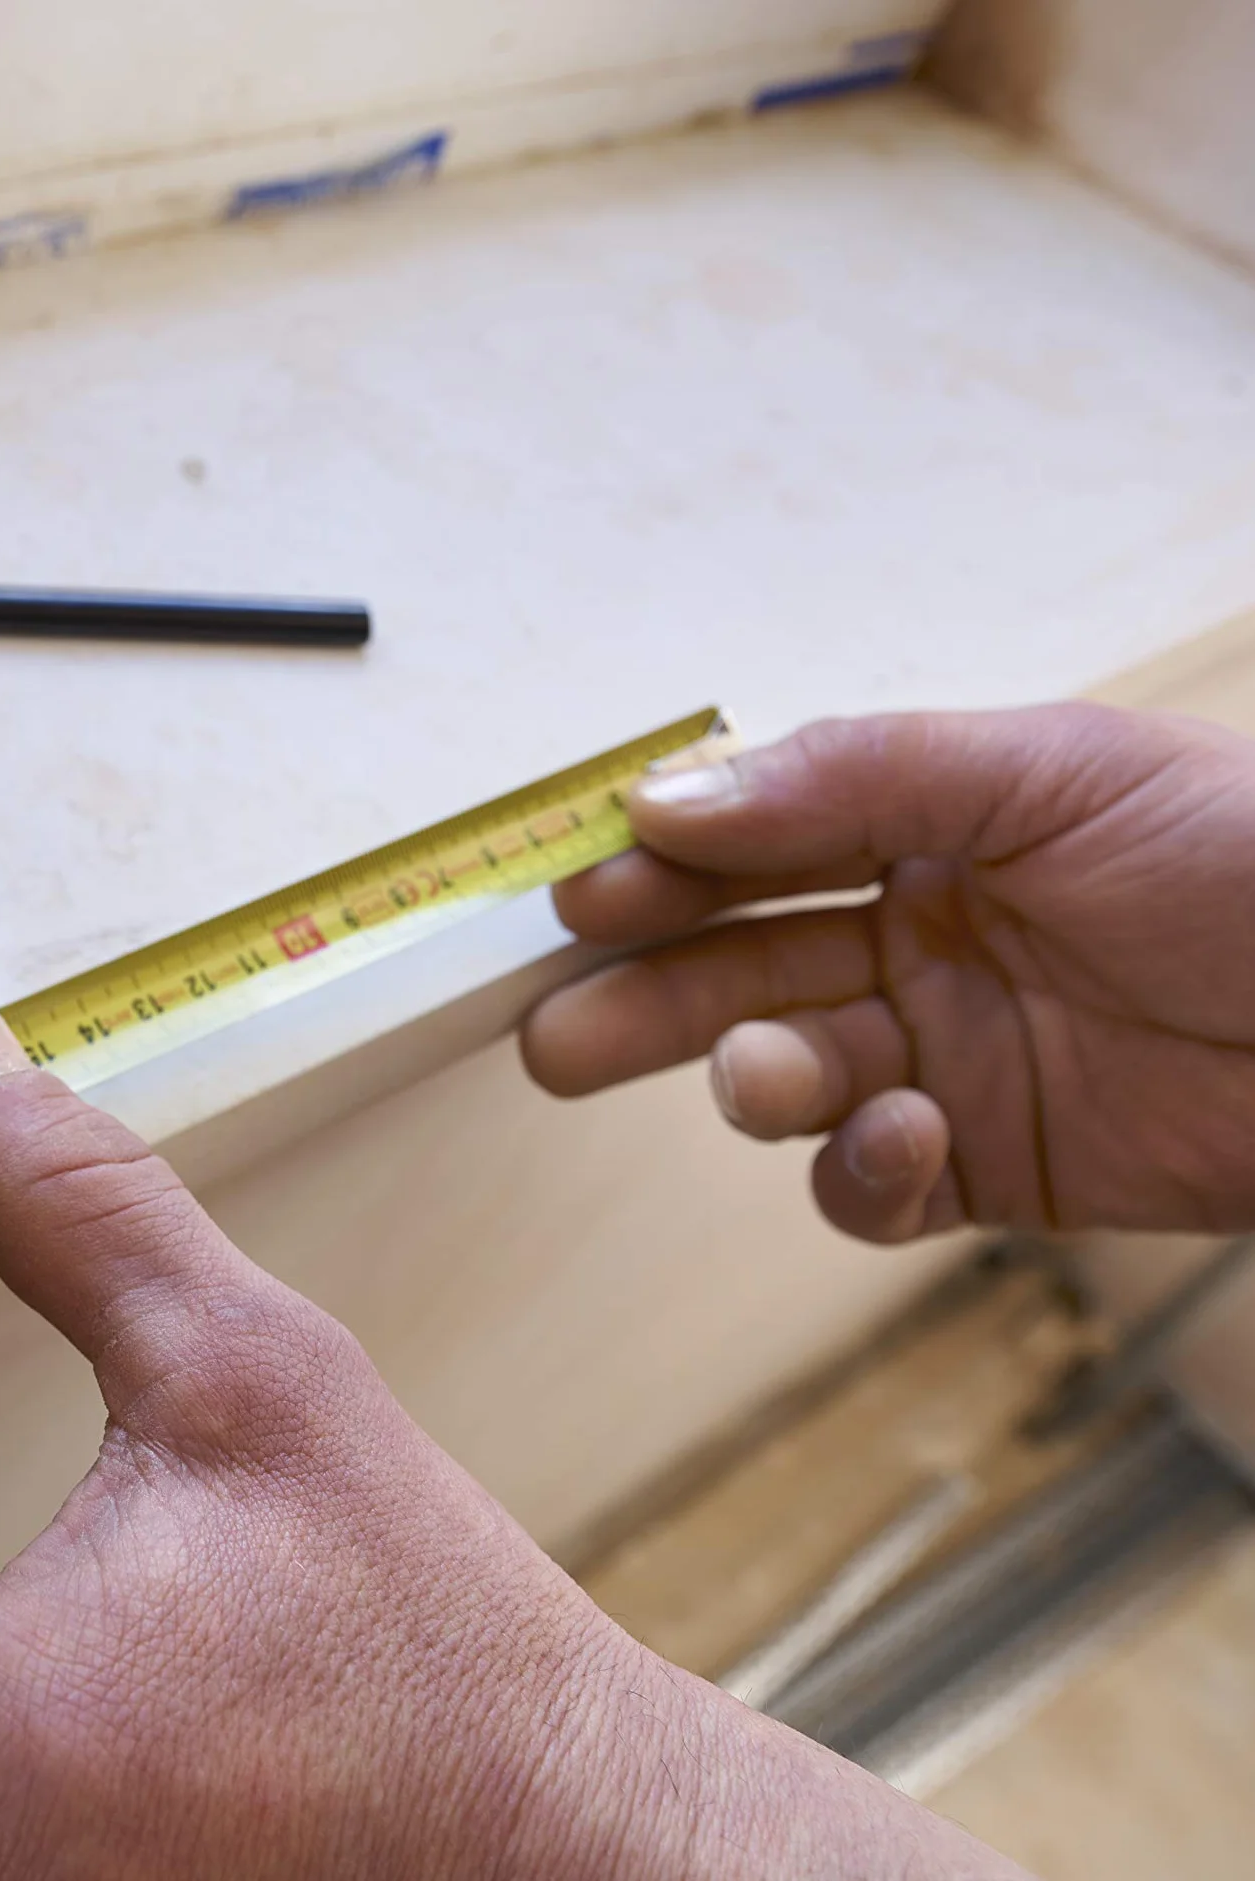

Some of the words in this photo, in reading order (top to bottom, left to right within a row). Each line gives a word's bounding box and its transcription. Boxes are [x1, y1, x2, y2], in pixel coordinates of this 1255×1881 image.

[282, 922, 319, 955] 10
[236, 948, 268, 975] 11
[183, 969, 216, 998] 12
[131, 994, 163, 1021] 13
[77, 1015, 110, 1045] 14
